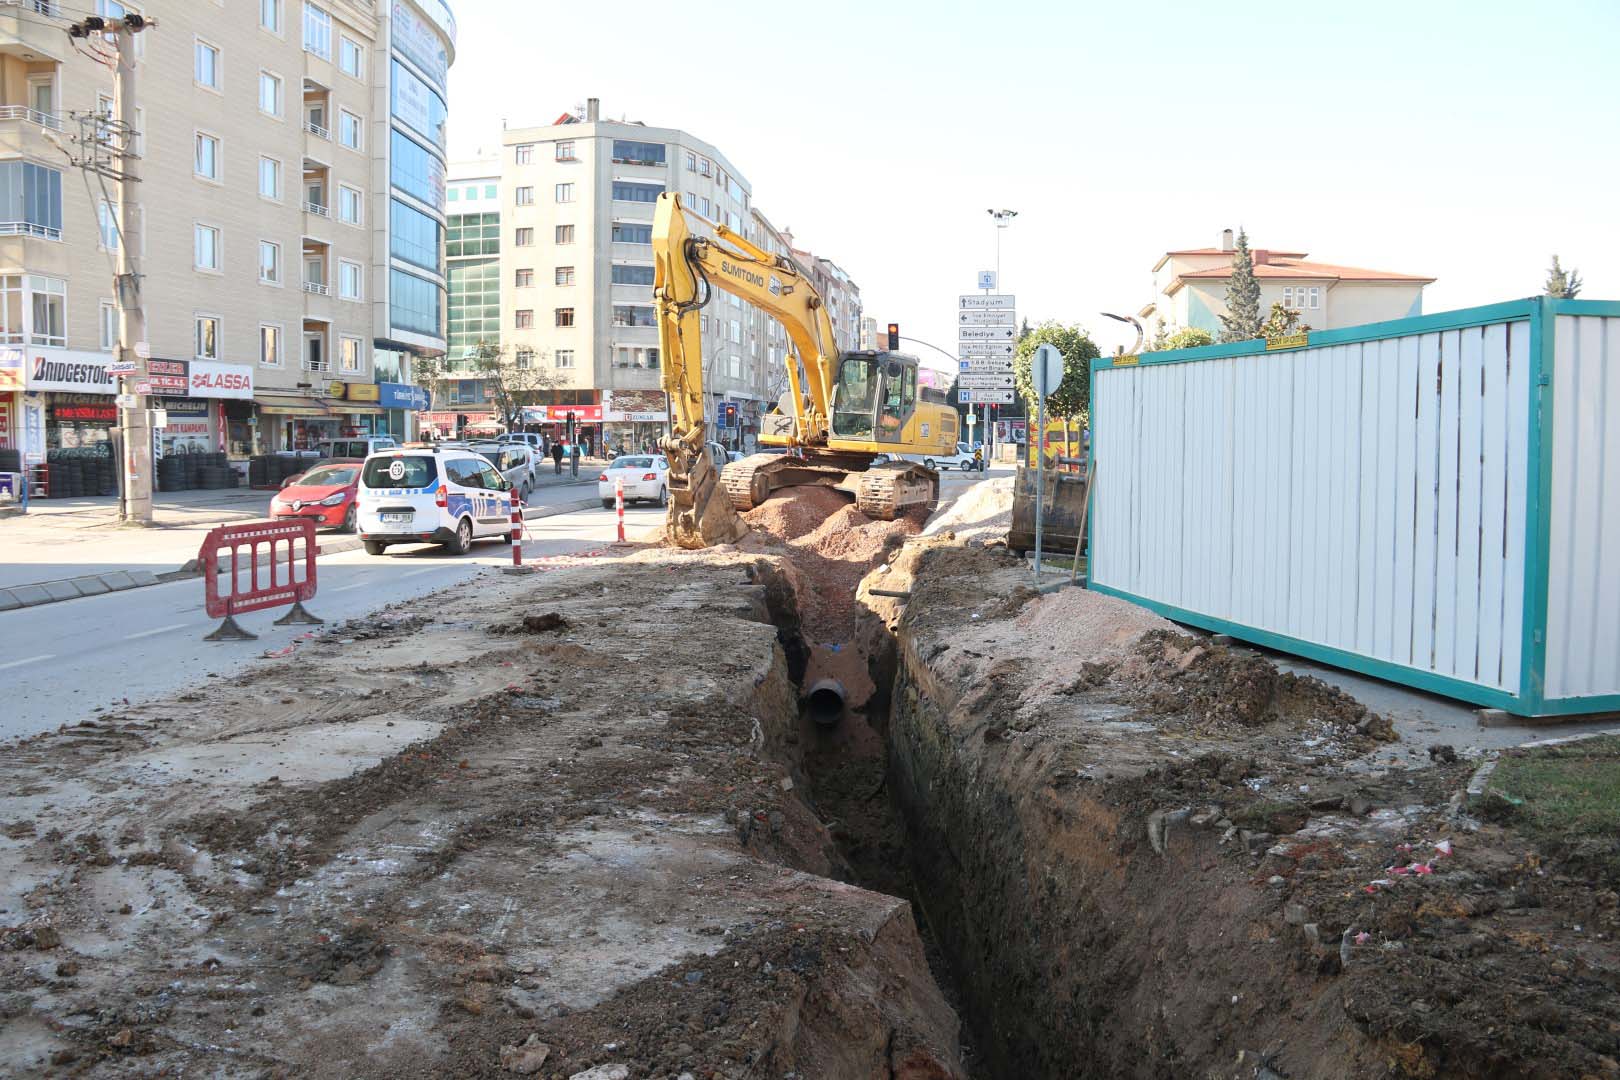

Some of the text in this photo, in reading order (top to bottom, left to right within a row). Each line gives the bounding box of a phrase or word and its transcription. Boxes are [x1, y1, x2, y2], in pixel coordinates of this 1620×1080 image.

[721, 260, 764, 288] SUMITOMO
[967, 299, 1003, 307] Stadyum
[962, 330, 995, 338] Belediye
[32, 357, 114, 384] BRIDGESTONE
[206, 373, 250, 389] LASSA
[165, 401, 207, 411] MICHELIN
